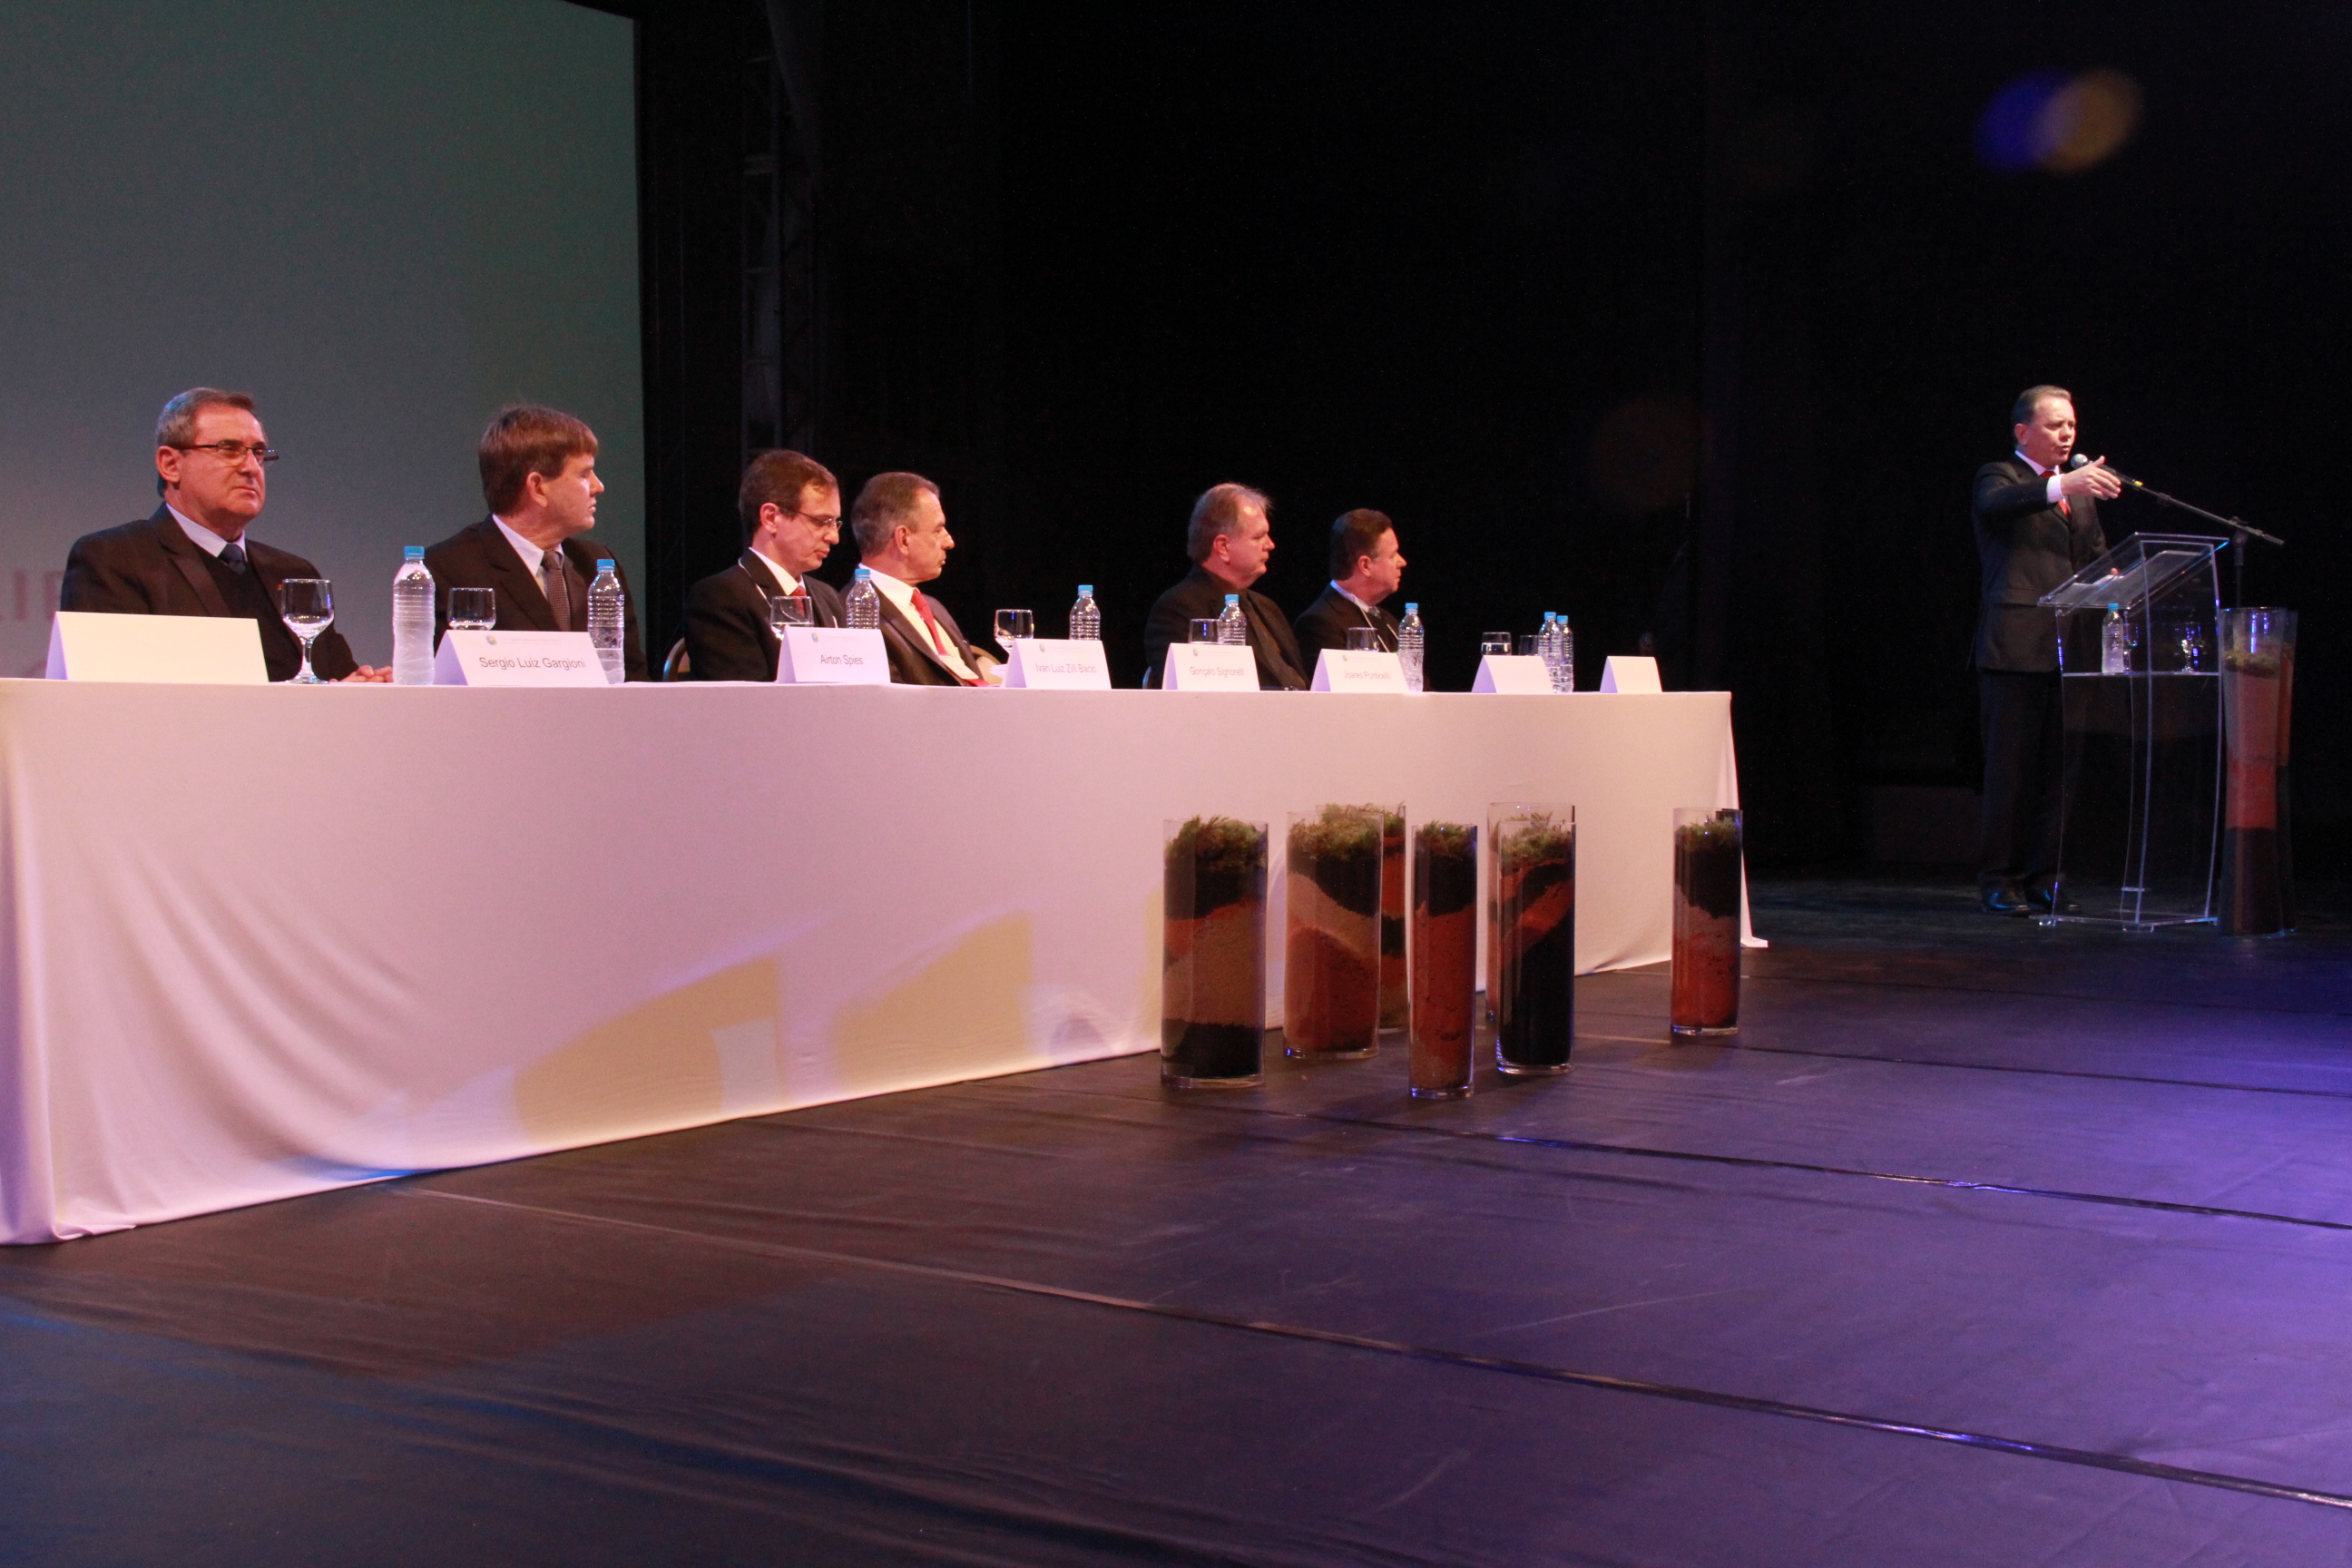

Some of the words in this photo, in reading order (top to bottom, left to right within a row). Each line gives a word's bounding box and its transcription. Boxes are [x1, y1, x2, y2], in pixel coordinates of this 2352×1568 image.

[479, 657, 515, 671] Sergio
[516, 657, 541, 668] Luiz
[542, 657, 587, 671] Gargioni
[820, 654, 842, 665] Airton
[843, 654, 864, 667] Spies
[1035, 663, 1051, 672] Ivan
